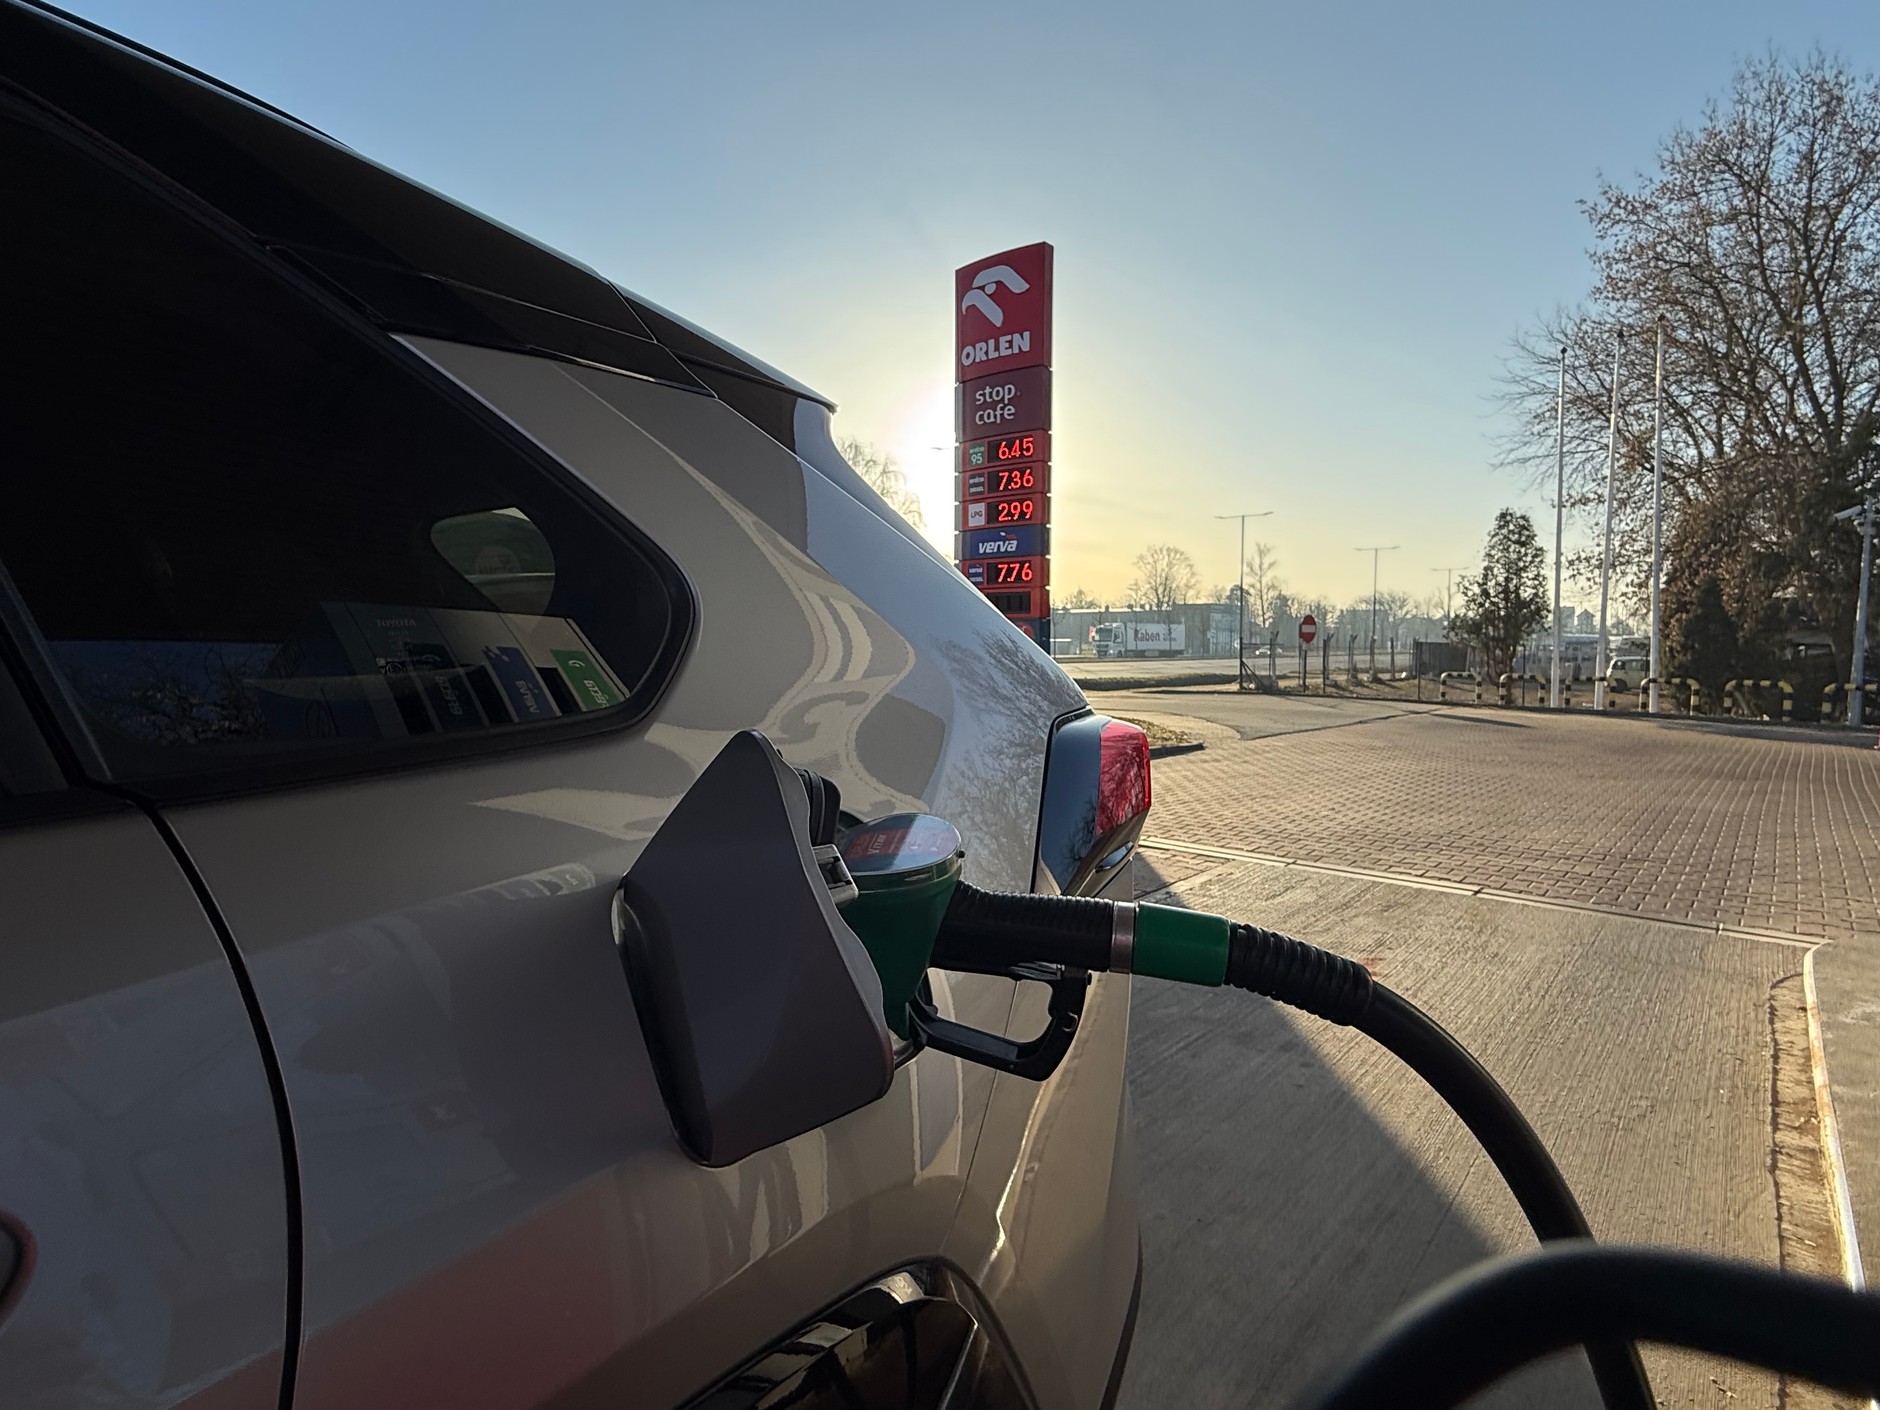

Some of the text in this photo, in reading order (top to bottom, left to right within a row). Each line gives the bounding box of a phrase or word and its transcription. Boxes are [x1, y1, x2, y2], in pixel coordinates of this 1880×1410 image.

[961, 331, 1031, 366] ORLEN
[975, 384, 1016, 405] stop
[975, 403, 1016, 425] cafe
[970, 453, 983, 465] 95
[998, 437, 1034, 460] 6.45
[998, 469, 1034, 491] 7.36
[970, 510, 983, 519] LPG
[998, 500, 1034, 522] 2.99
[978, 539, 1018, 554] verva
